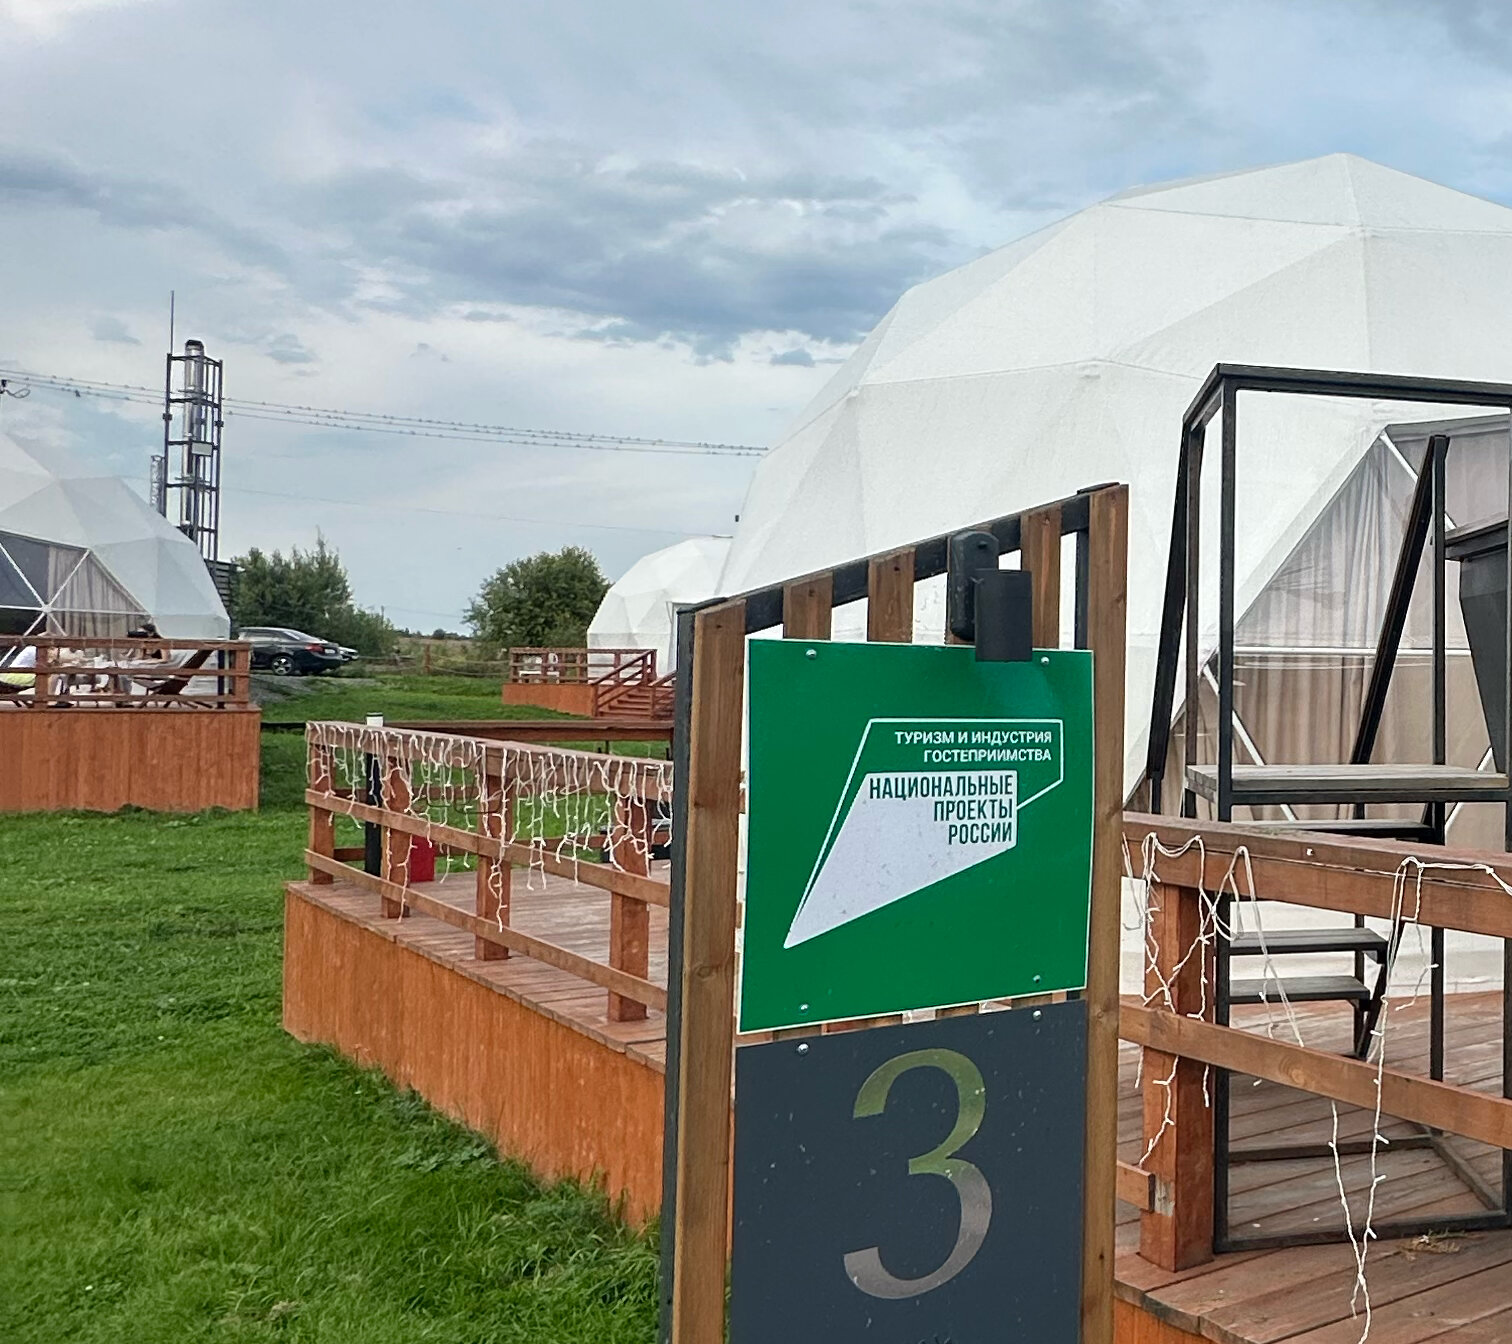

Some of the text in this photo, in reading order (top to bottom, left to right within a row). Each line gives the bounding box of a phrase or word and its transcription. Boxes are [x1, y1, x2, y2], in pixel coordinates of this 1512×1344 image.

[894, 731, 1052, 746] ТУРИЗМ И ИНДУСТРИЯ
[923, 748, 1052, 763] ГОСТЕПРИИМСТВА
[869, 774, 1013, 801] НАЦИОНАЛЬНЫЕ
[933, 798, 1013, 822] ПРОЕКТЫ
[948, 822, 1012, 845] РОССИИ
[843, 1048, 993, 1299] 3
